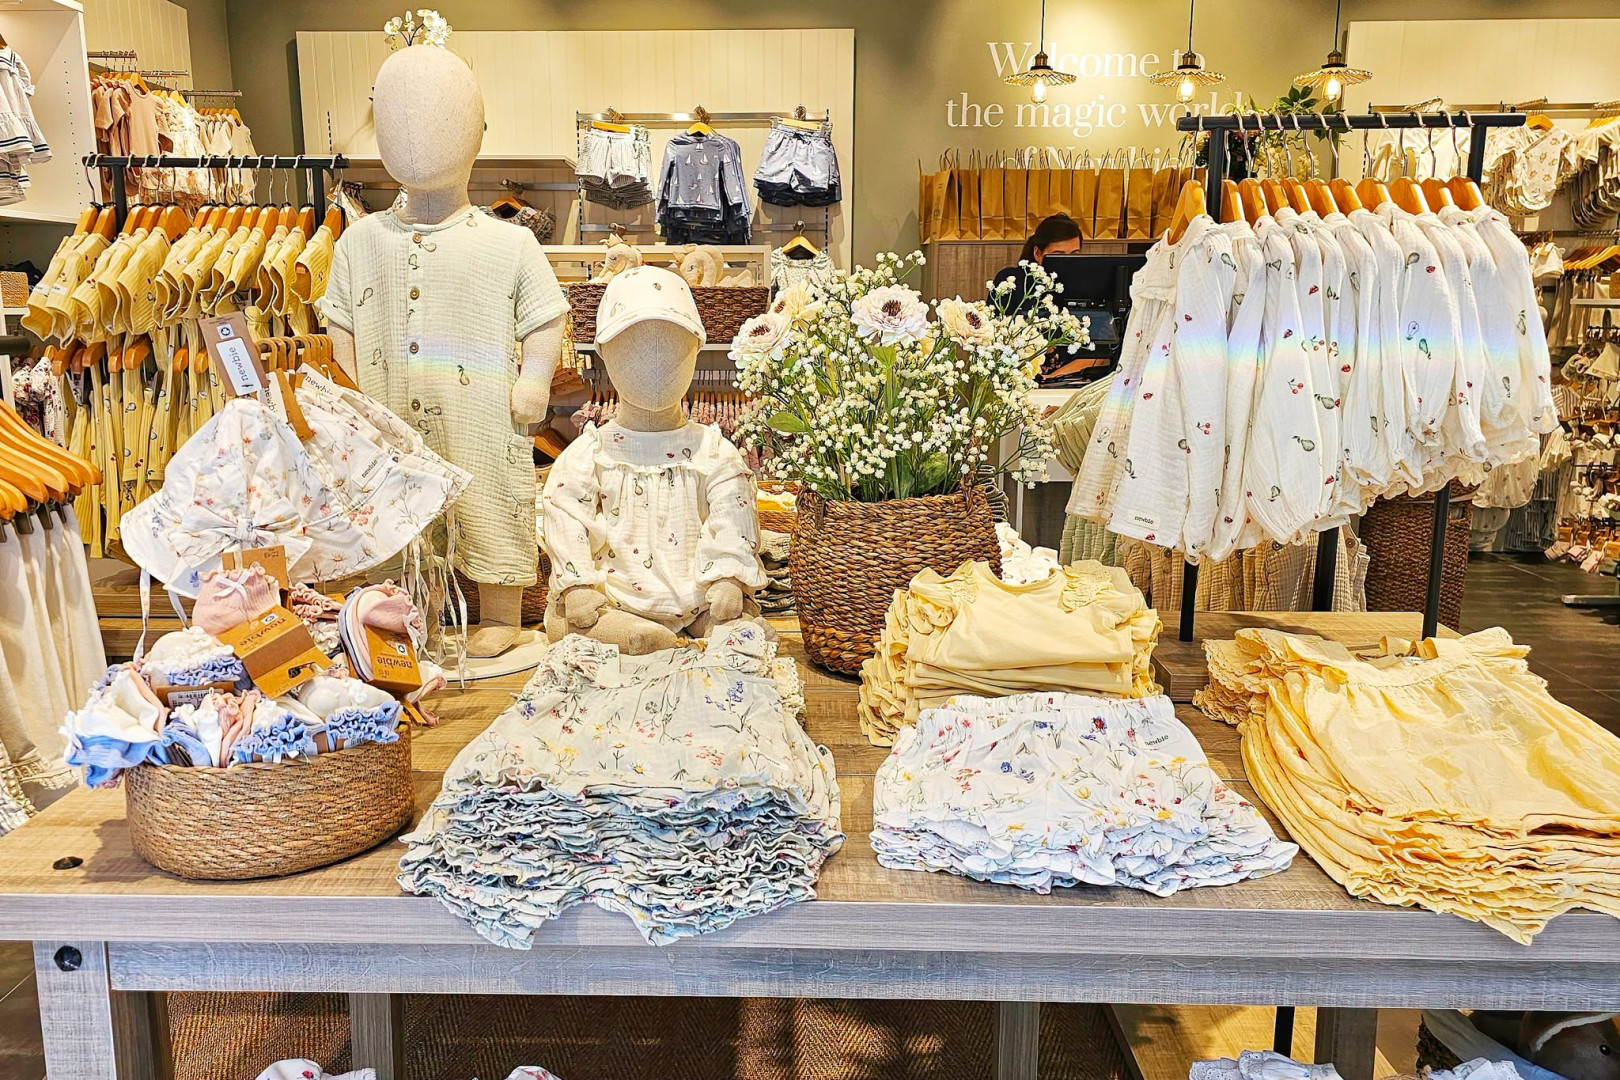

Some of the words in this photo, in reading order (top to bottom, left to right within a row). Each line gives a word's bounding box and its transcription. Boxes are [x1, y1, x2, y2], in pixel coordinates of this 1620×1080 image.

[986, 42, 1160, 78] Wlcome
[945, 92, 1004, 128] the
[1014, 94, 1127, 138] magic
[229, 346, 249, 382] newbie
[264, 385, 279, 413] newb
[305, 374, 334, 395] newbi
[239, 617, 287, 646] newbie
[377, 655, 413, 669] newbie
